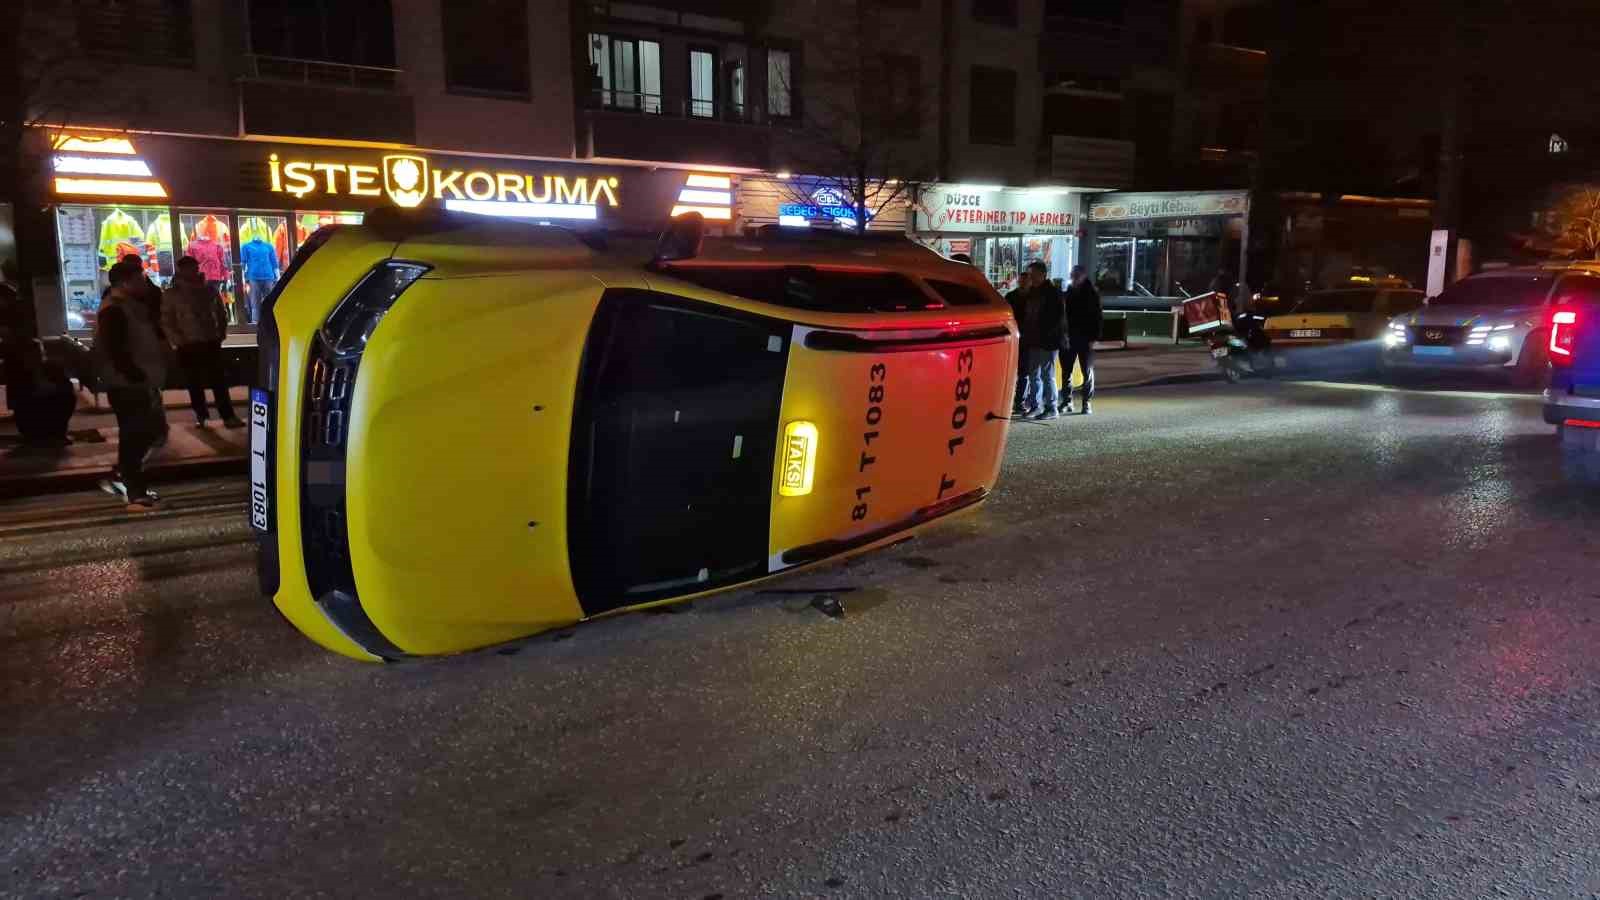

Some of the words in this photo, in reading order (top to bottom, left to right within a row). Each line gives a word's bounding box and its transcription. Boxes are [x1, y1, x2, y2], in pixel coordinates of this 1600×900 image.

[268, 153, 382, 199] İŞTE
[432, 169, 619, 207] KORUMA
[946, 193, 981, 206] DÜZCE
[1010, 211, 1026, 224] TIP
[253, 404, 266, 428] 81
[864, 363, 886, 445] 1083
[937, 473, 955, 499] T
[948, 348, 974, 456] 1083
[253, 449, 265, 462] T
[860, 451, 876, 472] T
[253, 481, 266, 528] 1083
[852, 486, 871, 521] 81
